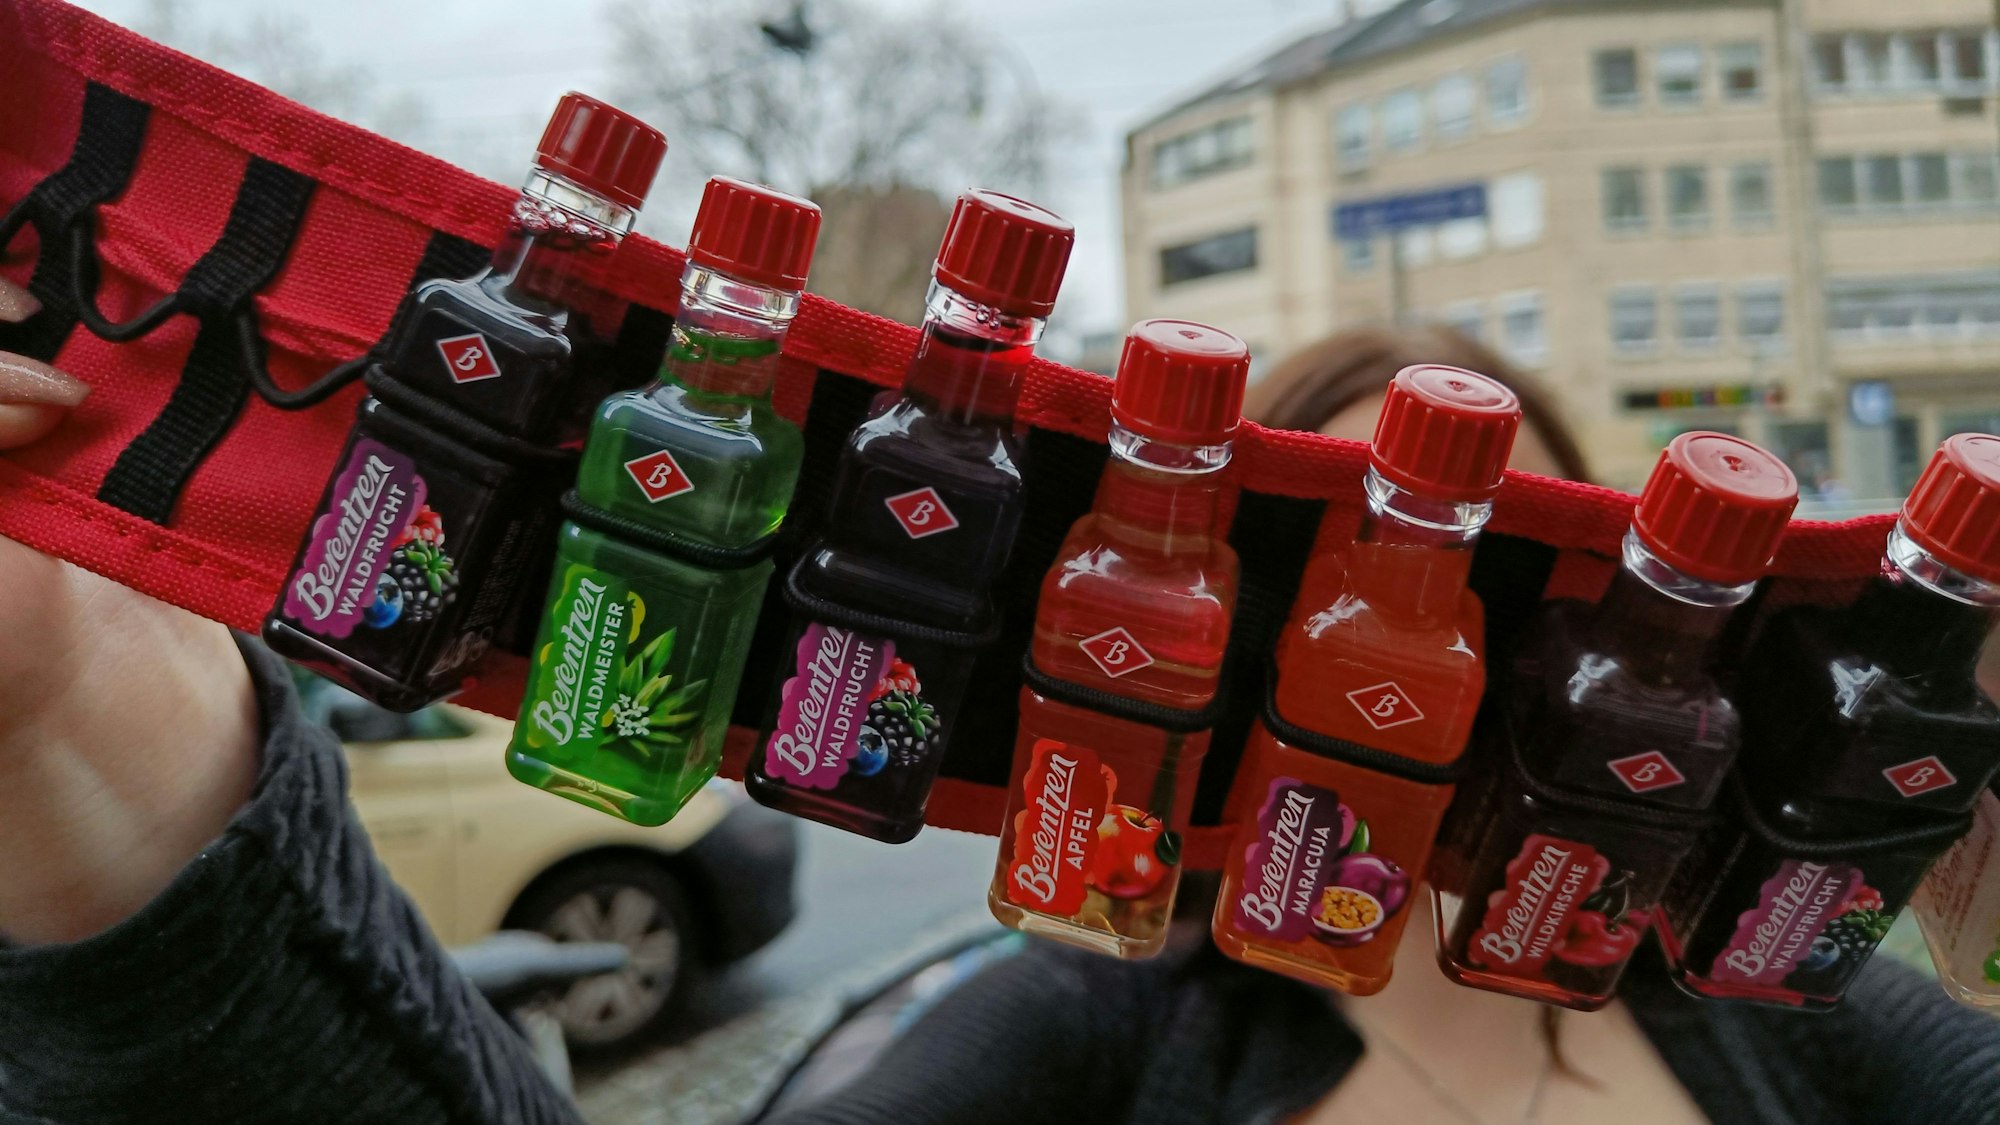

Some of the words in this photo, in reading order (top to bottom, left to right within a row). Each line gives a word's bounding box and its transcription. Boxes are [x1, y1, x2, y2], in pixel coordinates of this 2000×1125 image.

[455, 346, 483, 371] B
[646, 462, 672, 489] B
[907, 500, 936, 526] B
[296, 455, 394, 621] Berentzen
[337, 483, 407, 616] WALDFRUCHT
[533, 578, 607, 746] Berentzen
[577, 602, 624, 738] WALDMEISTER
[1103, 640, 1130, 665] B
[822, 641, 874, 767] WALDFRUCHT
[1371, 693, 1400, 717] B
[1631, 762, 1662, 782] B
[1904, 767, 1936, 786] B
[1015, 753, 1078, 903] Berentzen
[1065, 807, 1093, 870] APFEL
[1240, 790, 1315, 931] Berentzen
[1291, 827, 1331, 915] MARACUJA
[1480, 845, 1571, 964] Berentzen
[1527, 863, 1589, 958] WILDKIRSCHE
[1725, 861, 1829, 977] Berentzen
[1769, 877, 1843, 969] WALDFRUCHT
